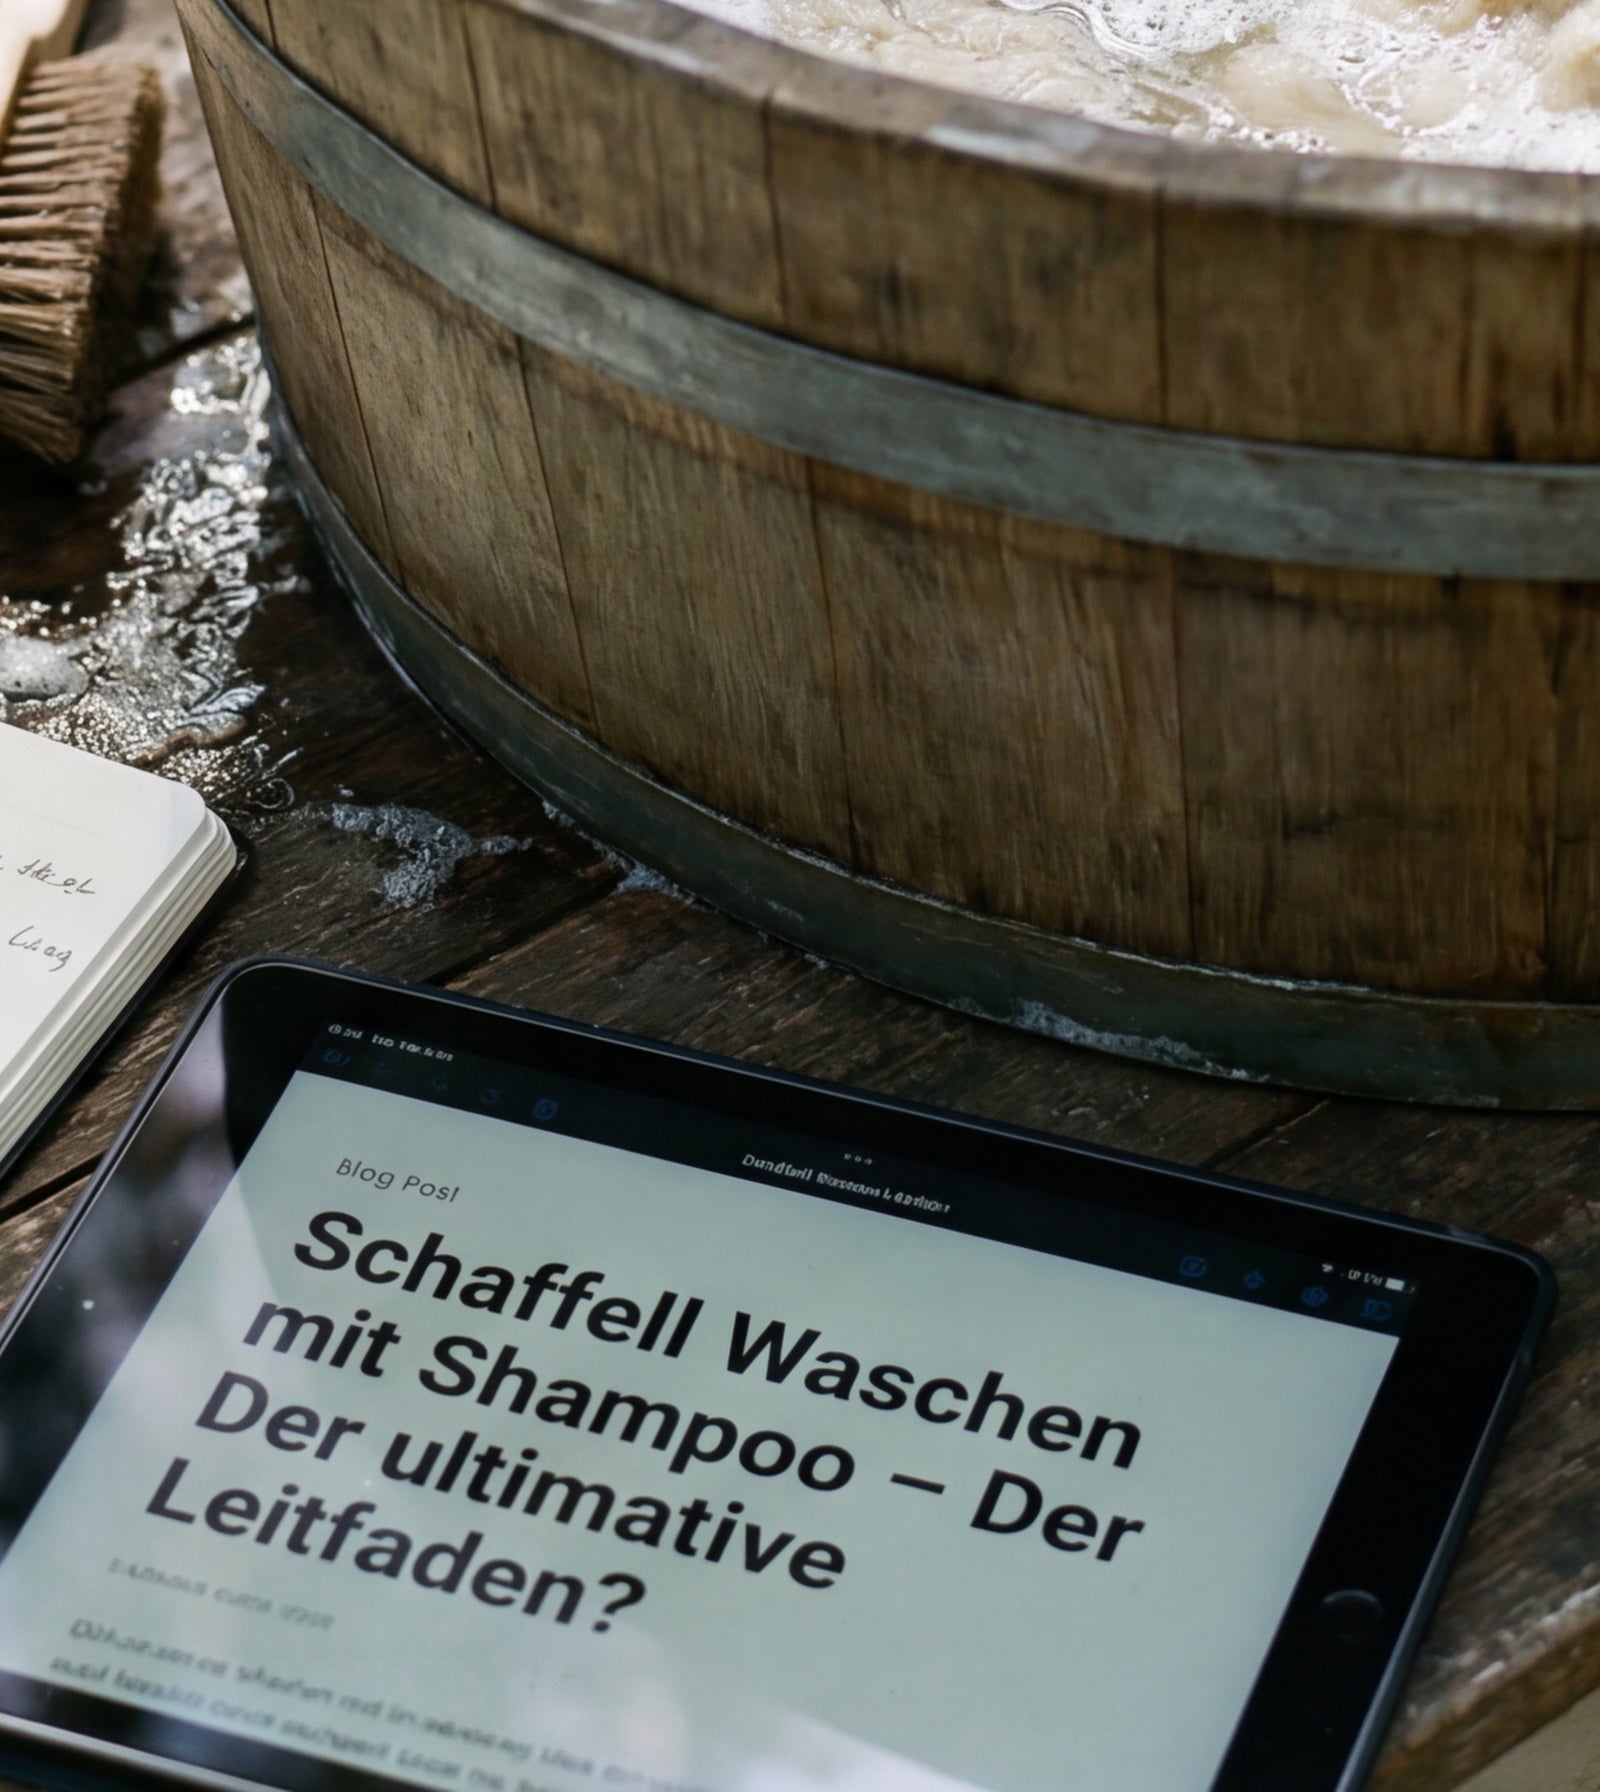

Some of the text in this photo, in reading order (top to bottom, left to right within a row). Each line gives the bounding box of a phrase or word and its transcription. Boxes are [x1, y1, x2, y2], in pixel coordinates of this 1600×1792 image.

[335, 1157, 396, 1190] Blog
[243, 1302, 403, 1379] mit
[417, 1334, 856, 1493] Shampoo
[969, 1468, 1146, 1563] Der
[293, 1210, 1142, 1471] Schaffell Waschen
[145, 1457, 647, 1634] Leitfaden?
[195, 1371, 846, 1590] Der ultimative
